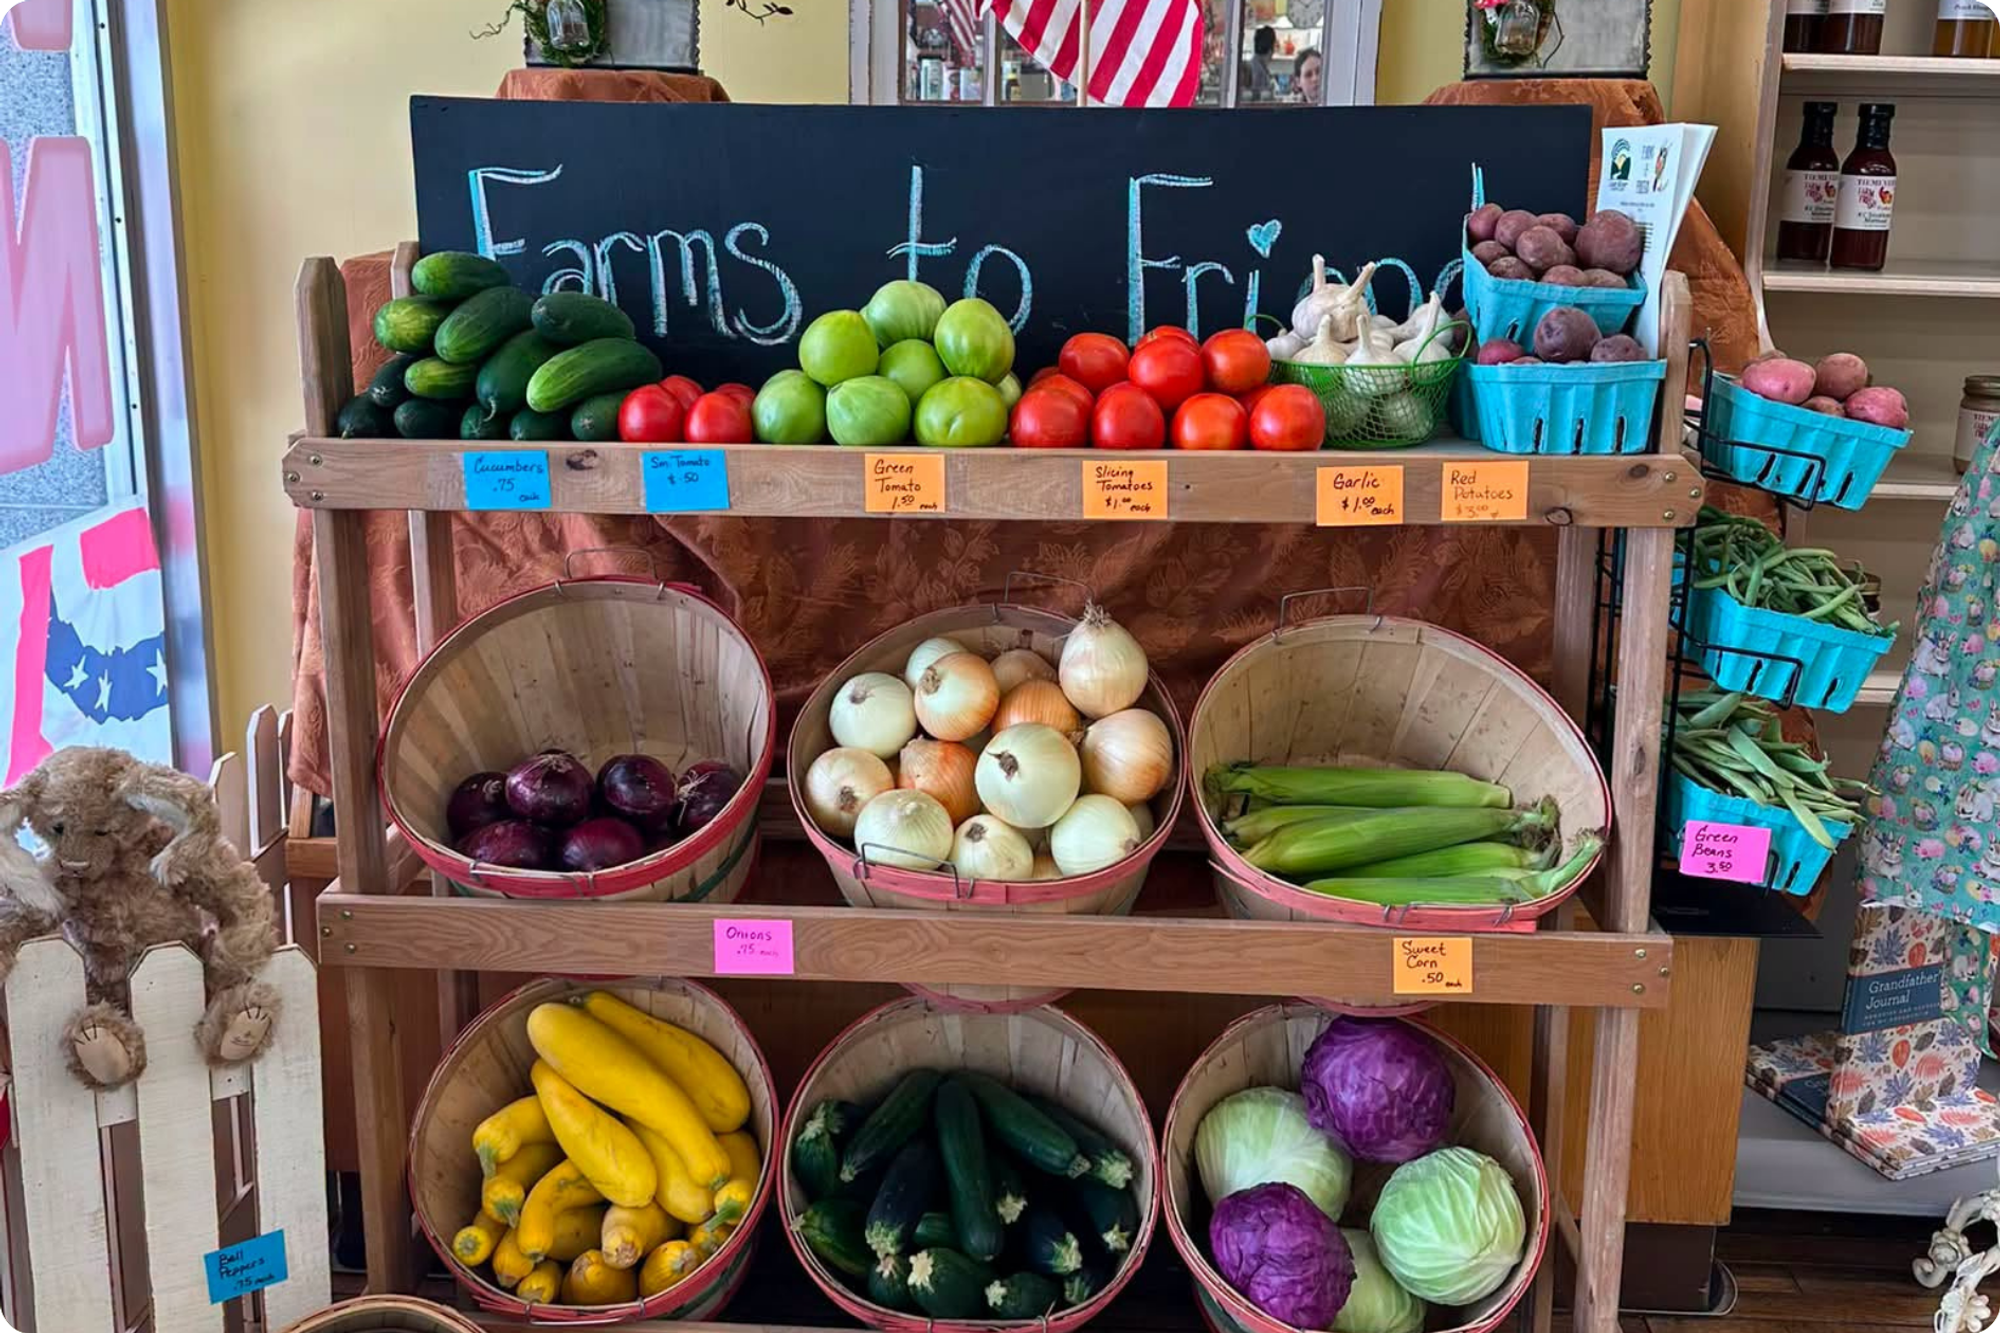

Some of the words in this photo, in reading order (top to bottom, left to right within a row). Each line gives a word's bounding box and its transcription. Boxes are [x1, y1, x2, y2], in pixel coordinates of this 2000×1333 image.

[468, 163, 803, 346] Farms
[886, 165, 1033, 337] to
[474, 455, 544, 474] Cucumbers
[670, 454, 710, 468] Tomato
[874, 458, 914, 475] Green
[1095, 465, 1134, 483] Slicing
[1333, 471, 1380, 490] Garlic
[1450, 469, 1477, 485] Red
[493, 478, 515, 492] .75
[874, 476, 921, 493] Tomato
[1096, 479, 1153, 492] Tomatoes
[1454, 485, 1513, 501] Potatoes
[891, 495, 915, 510] 1.50
[1130, 503, 1151, 513] each
[1371, 503, 1395, 516] each
[1694, 825, 1738, 844] Green
[1691, 843, 1732, 859] Beans
[1704, 861, 1732, 874] 3.50
[726, 926, 772, 941] Onions
[1401, 940, 1447, 956] Sweet
[1406, 954, 1438, 969] Corn
[1421, 971, 1444, 984] .50
[1865, 989, 1911, 1010] Journal
[219, 1249, 244, 1266] Bell
[219, 1257, 265, 1280] Peppers
